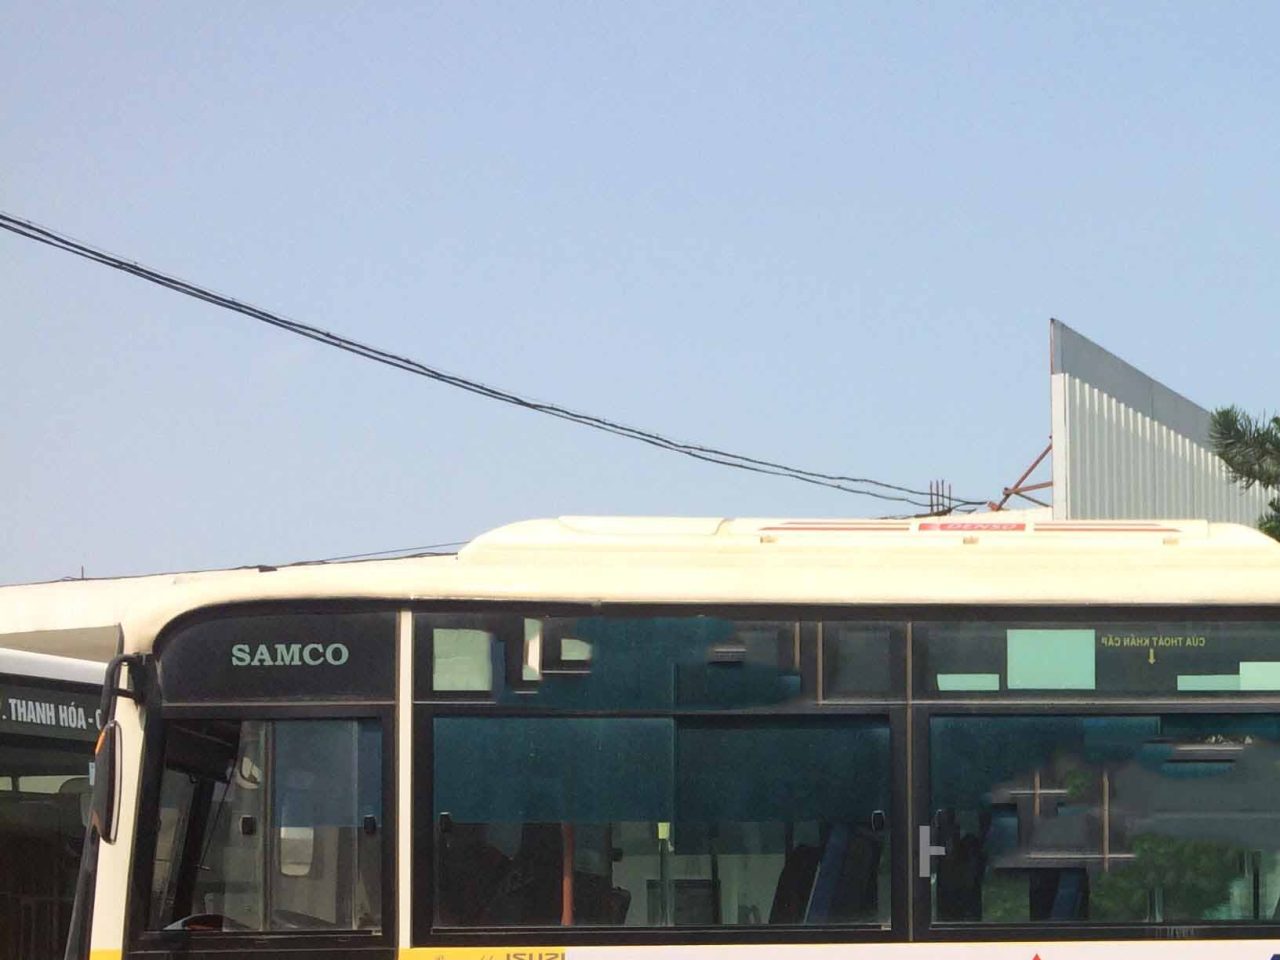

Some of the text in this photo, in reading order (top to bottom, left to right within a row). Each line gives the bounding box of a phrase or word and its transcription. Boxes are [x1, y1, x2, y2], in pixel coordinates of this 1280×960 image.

[231, 643, 350, 666] SAMCO
[8, 698, 56, 726] THANH
[58, 701, 87, 730] HÓA
